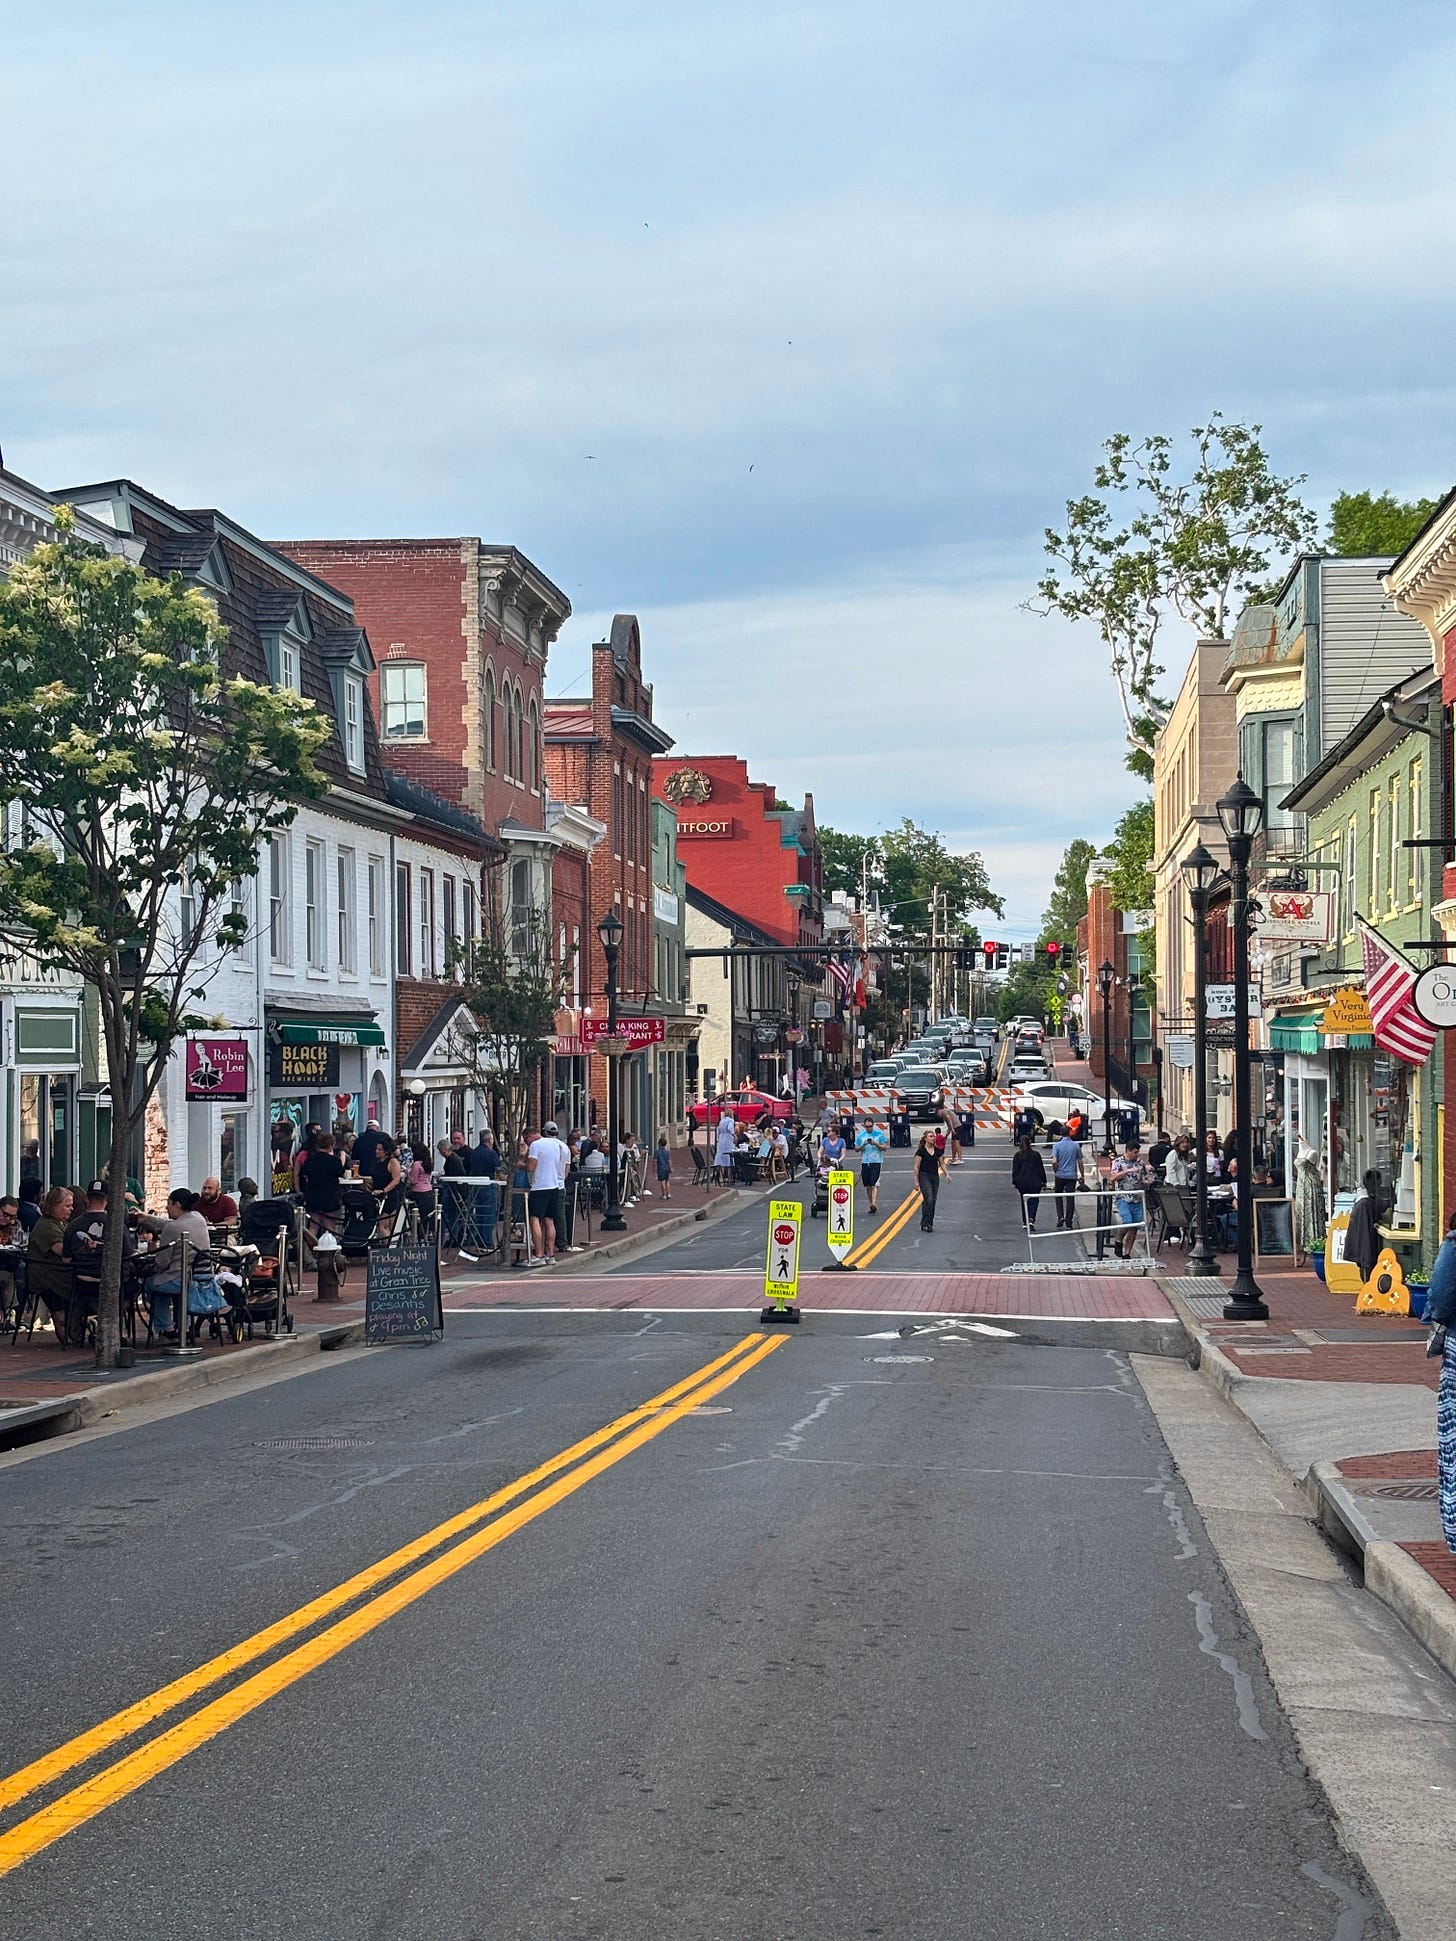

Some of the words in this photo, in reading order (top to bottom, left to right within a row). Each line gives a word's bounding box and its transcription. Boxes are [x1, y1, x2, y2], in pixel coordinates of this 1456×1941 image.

[676, 822, 728, 833] TFOOT
[1208, 994, 1258, 1004] OYSR
[1340, 1000, 1364, 1012] Very
[213, 1048, 244, 1060] Robin
[282, 1046, 327, 1060] BLACK
[226, 1060, 244, 1072] Lee
[282, 1060, 327, 1075] HOOF
[775, 1203, 796, 1212] STATE
[775, 1230, 794, 1240] STOP
[370, 1250, 400, 1266] Friday
[403, 1250, 428, 1264] Night
[372, 1264, 391, 1276] Live
[394, 1266, 423, 1275] music
[370, 1278, 378, 1287] at
[380, 1276, 408, 1288] Green
[409, 1275, 431, 1285] Tree
[369, 1312, 403, 1323] playing
[407, 1310, 418, 1319] at
